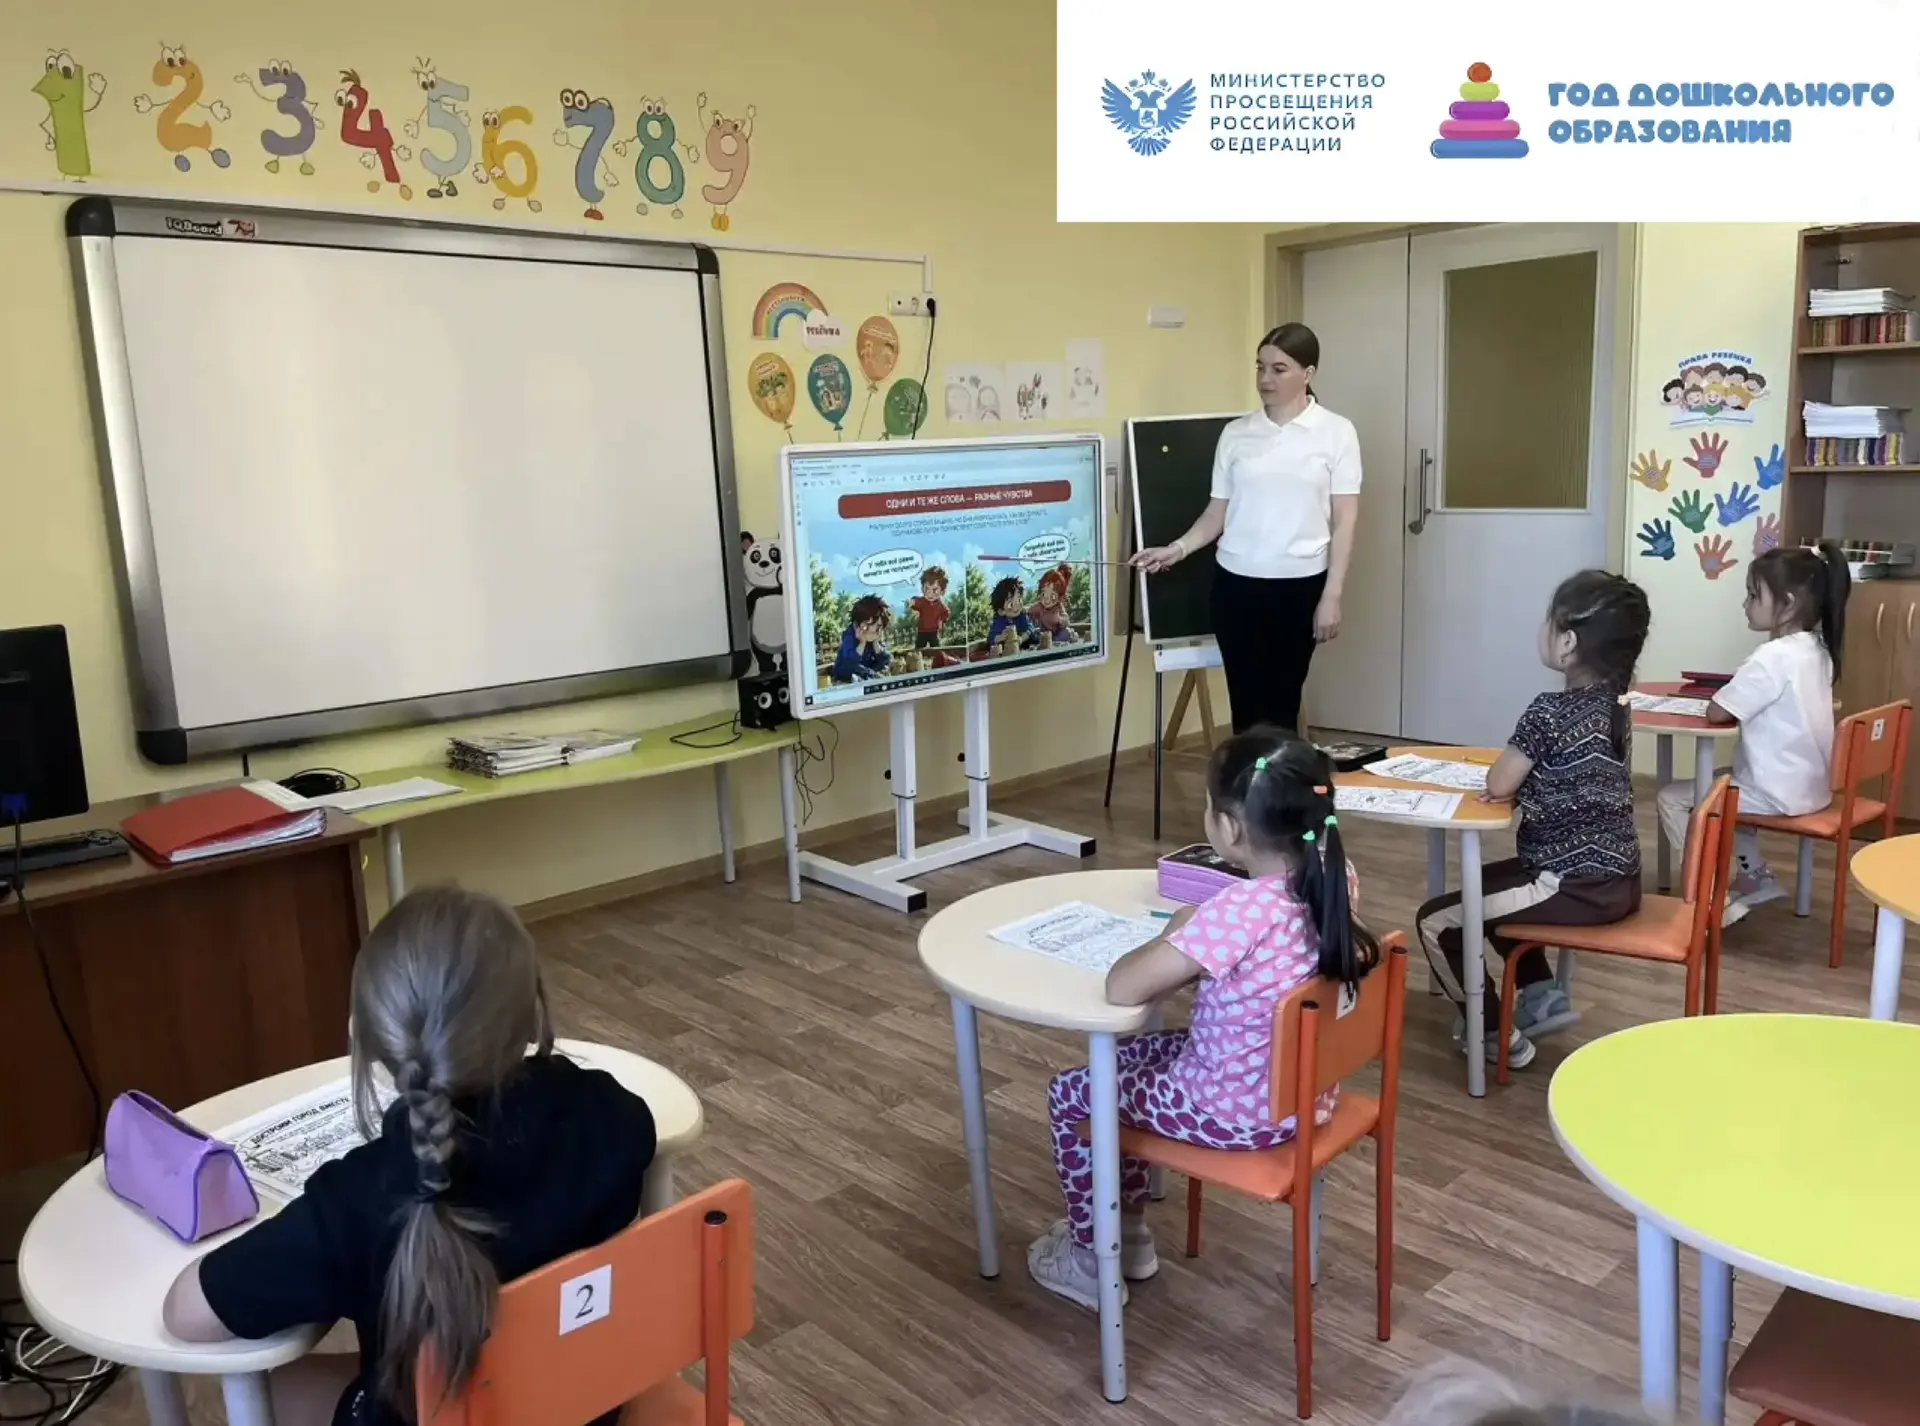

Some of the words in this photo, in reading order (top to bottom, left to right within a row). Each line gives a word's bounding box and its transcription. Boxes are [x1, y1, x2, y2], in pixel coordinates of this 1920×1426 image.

[32, 63, 91, 176] 1
[153, 58, 213, 152] 2
[258, 67, 315, 156] 3
[341, 84, 399, 183] 4
[420, 76, 472, 177] 5
[482, 105, 537, 197] 6
[562, 97, 614, 203] 7
[635, 112, 685, 205] 8
[702, 118, 750, 205] 9
[917, 496, 926, 507] ТЕ
[927, 495, 939, 505] ЖЕ
[940, 493, 965, 504] СЛОВА
[575, 1284, 594, 1320] 2
